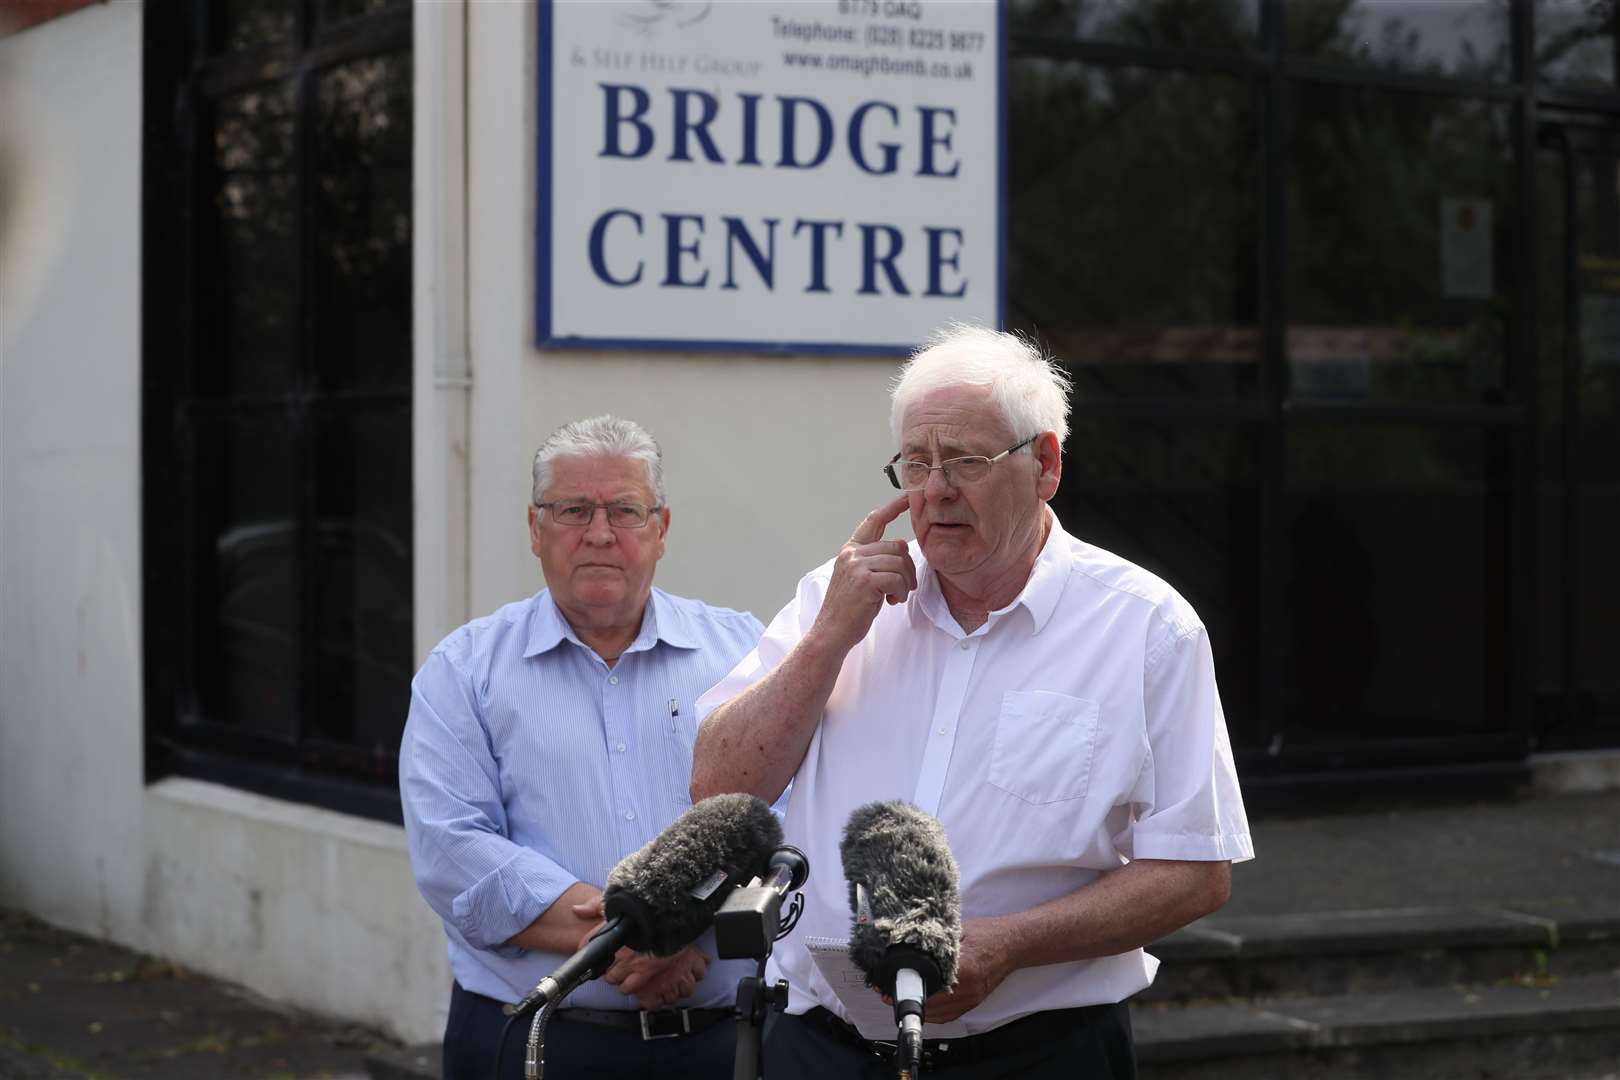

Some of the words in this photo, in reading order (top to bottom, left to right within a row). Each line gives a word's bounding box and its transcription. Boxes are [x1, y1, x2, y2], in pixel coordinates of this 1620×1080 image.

[772, 16, 857, 44] Telephone:
[864, 24, 903, 49] (028)
[570, 46, 586, 67] &
[782, 51, 974, 81] www.omaghbomb.co.uk
[599, 83, 959, 179] BRIDGE
[587, 209, 966, 299] CENTRE
